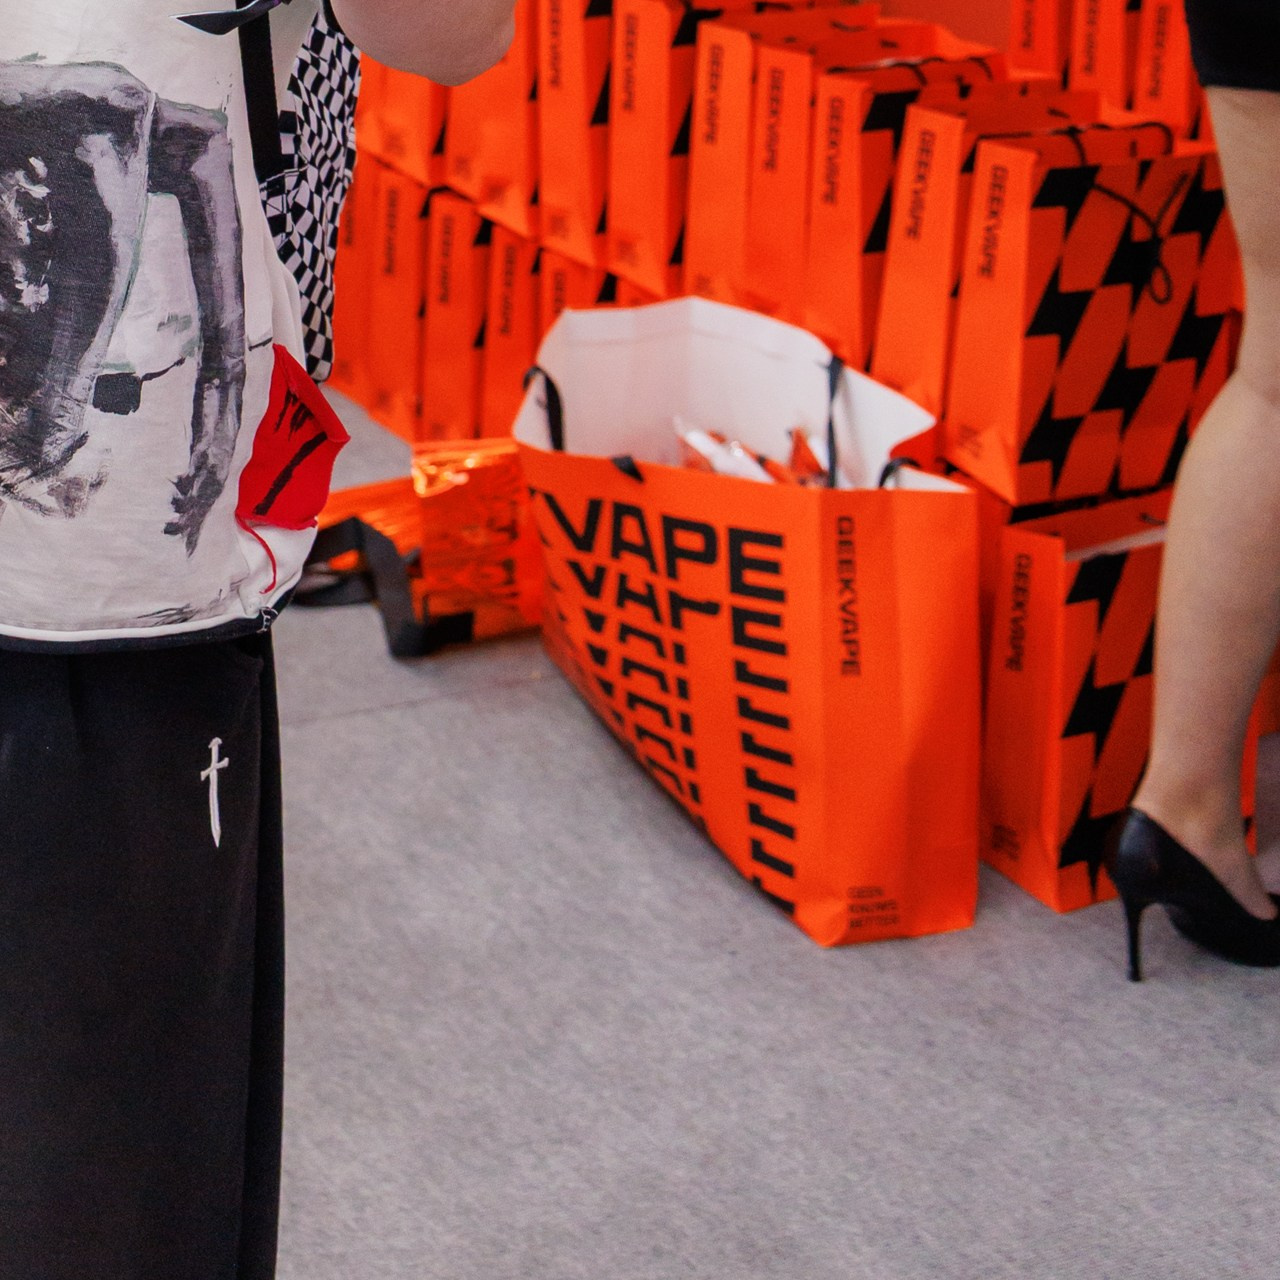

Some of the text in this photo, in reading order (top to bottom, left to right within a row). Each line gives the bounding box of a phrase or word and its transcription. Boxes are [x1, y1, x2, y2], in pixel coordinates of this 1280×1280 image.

[980, 164, 1009, 278] GEEKVAPE
[836, 515, 862, 677] GEEKVAPE
[1006, 551, 1033, 673] GEEKVAPE
